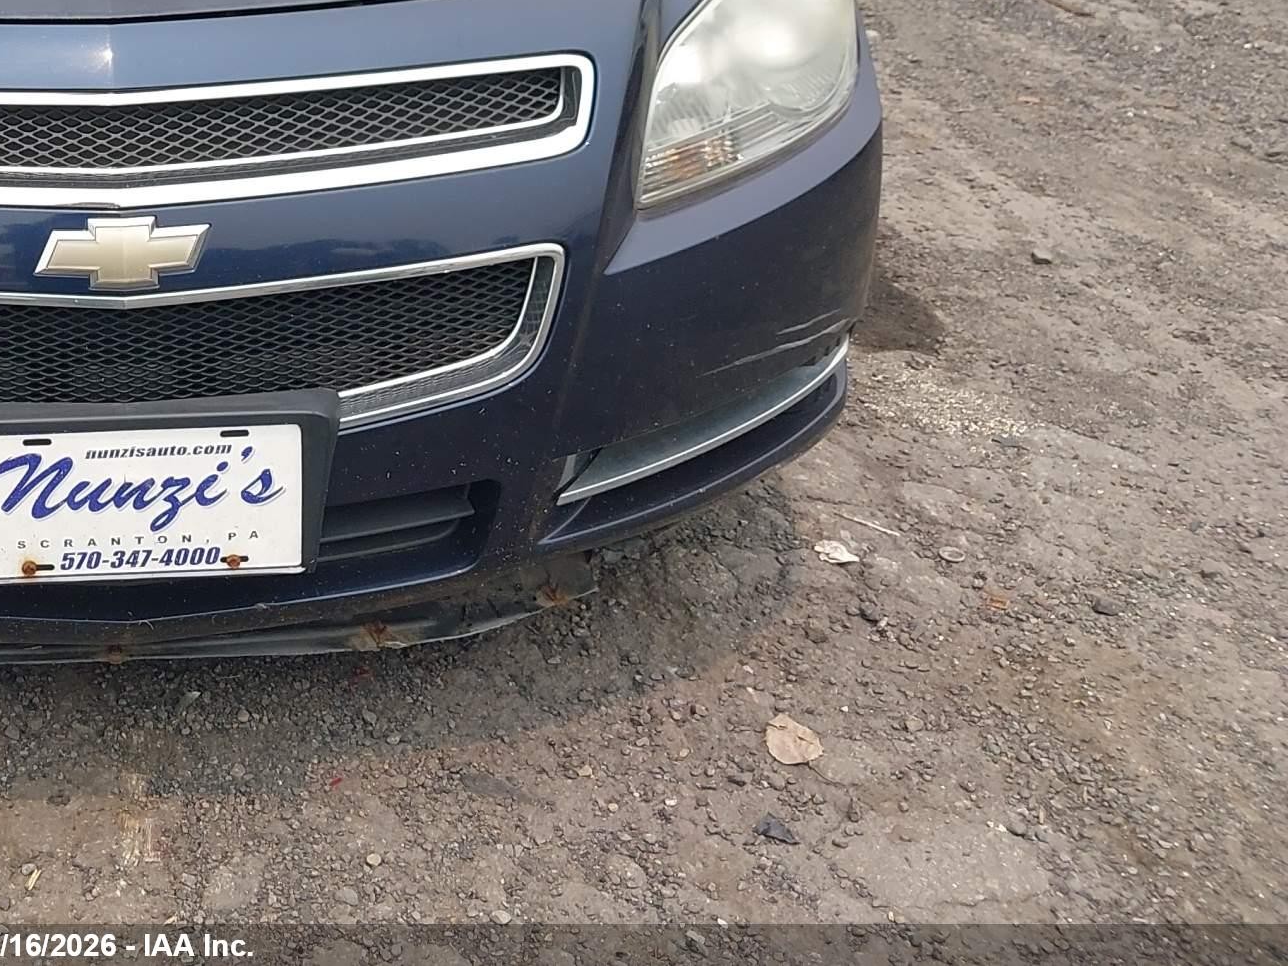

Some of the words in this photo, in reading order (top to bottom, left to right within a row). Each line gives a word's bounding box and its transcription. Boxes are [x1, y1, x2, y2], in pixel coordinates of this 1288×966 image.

[85, 444, 233, 460] nunzisauto.com
[16, 534, 210, 549] SCRANTON,
[227, 530, 259, 541] PA
[59, 546, 221, 571] 570-347-4000
